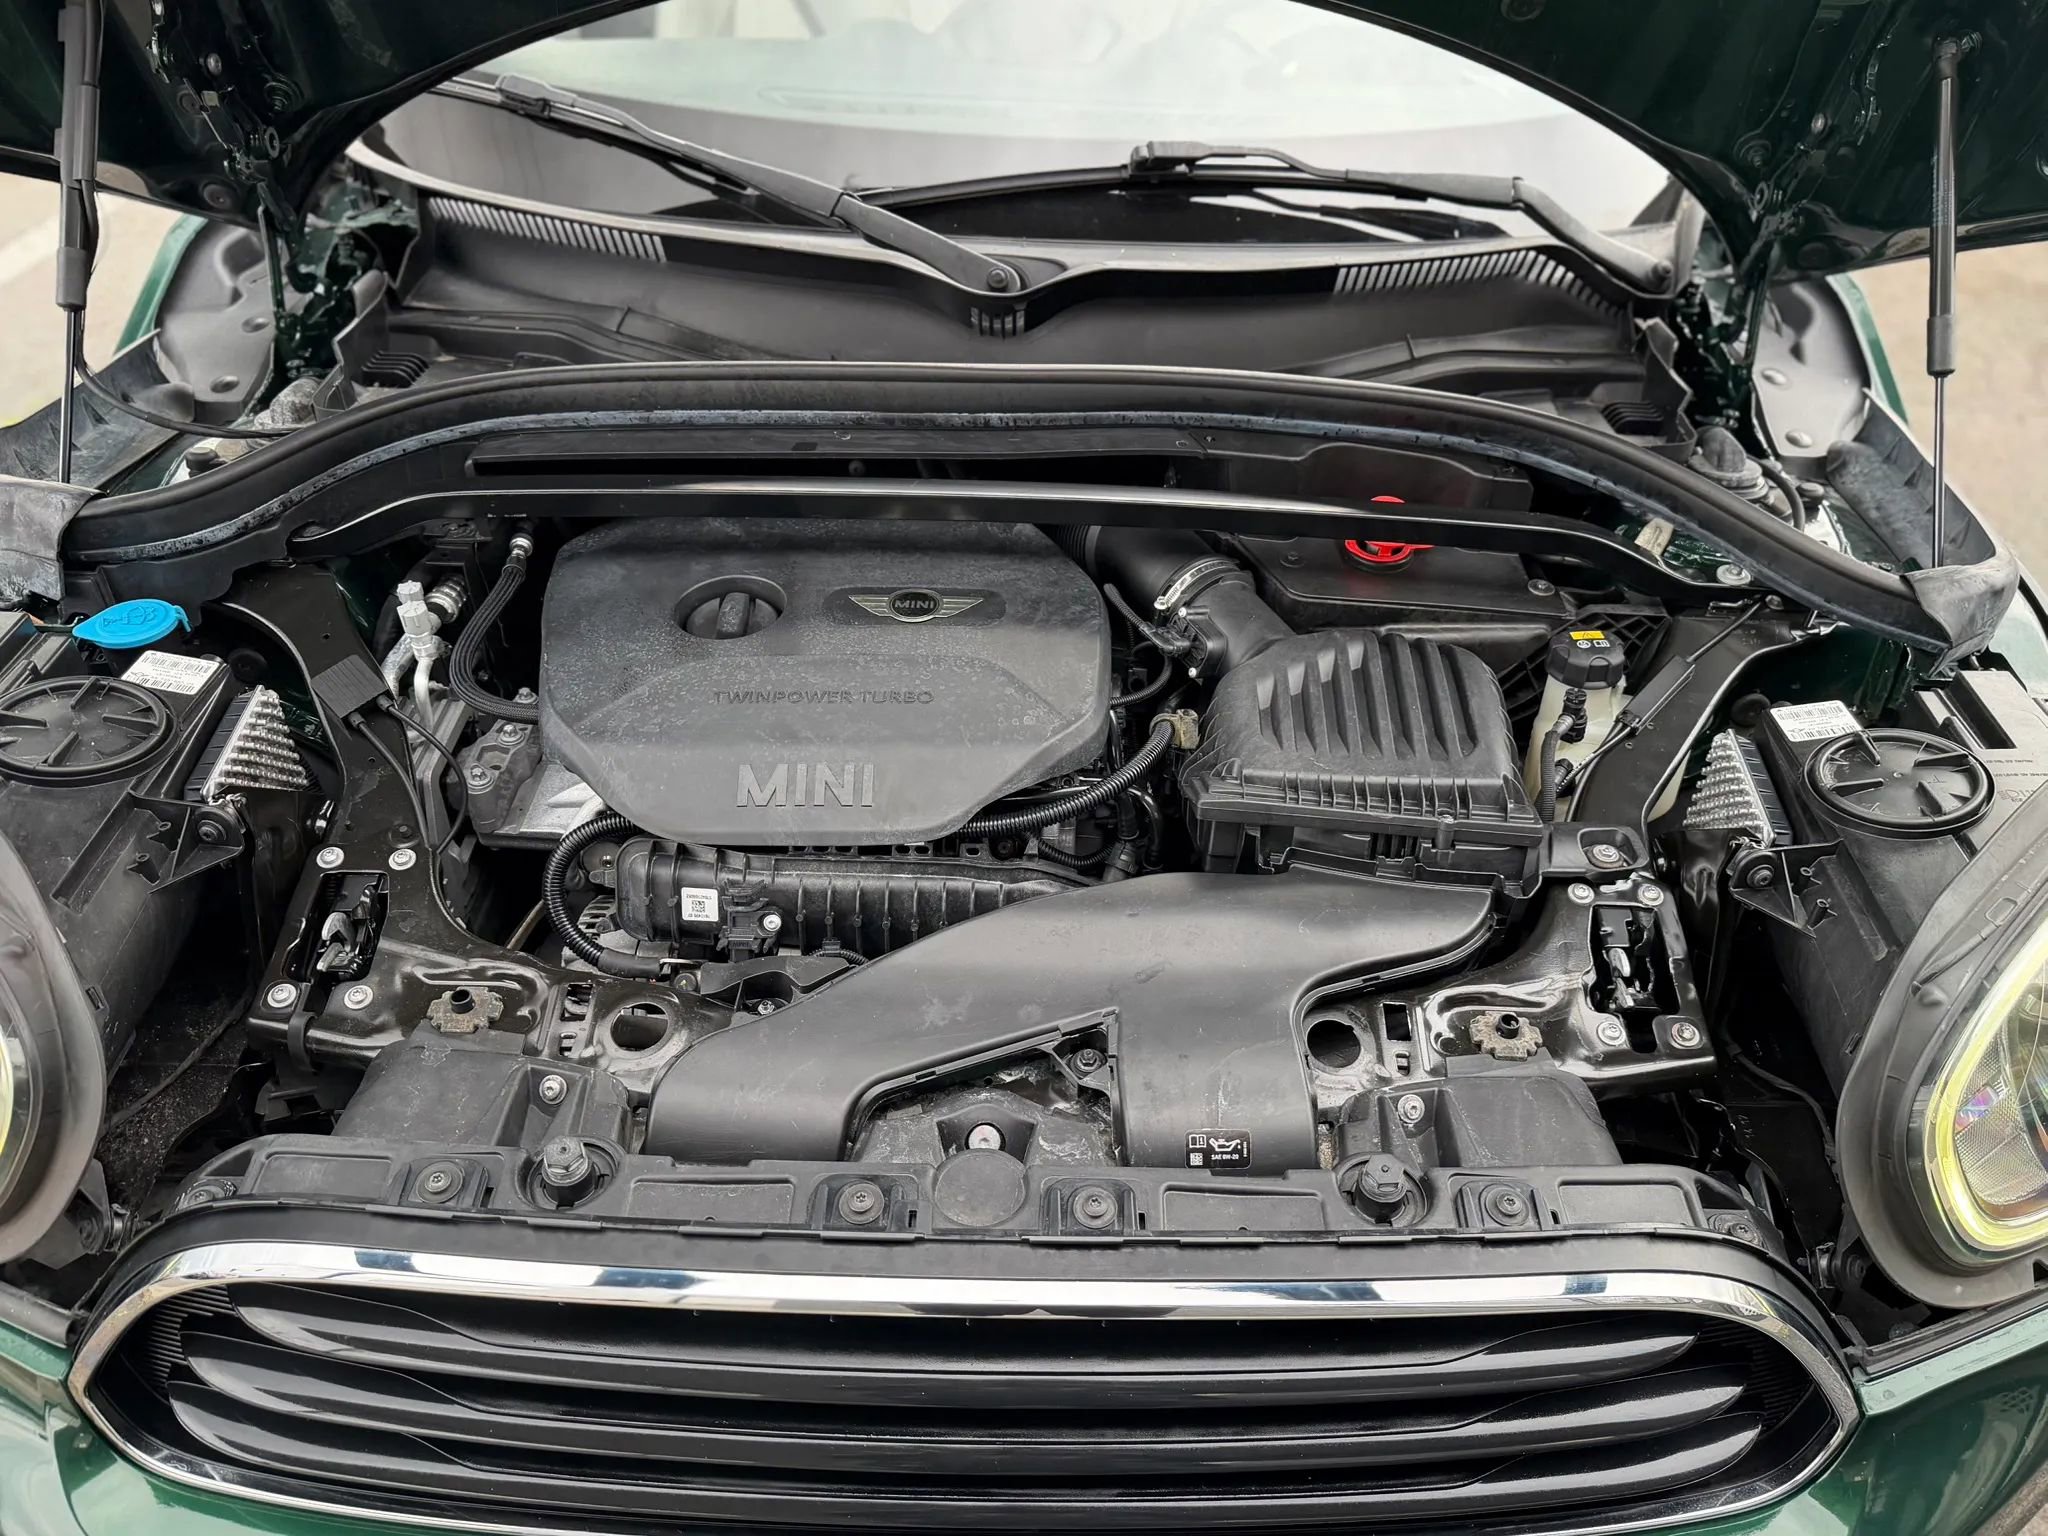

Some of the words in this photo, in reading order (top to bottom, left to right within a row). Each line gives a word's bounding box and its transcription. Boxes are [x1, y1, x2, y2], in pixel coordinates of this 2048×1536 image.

[894, 599, 934, 609] MINI
[714, 690, 853, 705] TWINPOWER
[859, 691, 935, 705] TURBO
[736, 763, 875, 808] MINI
